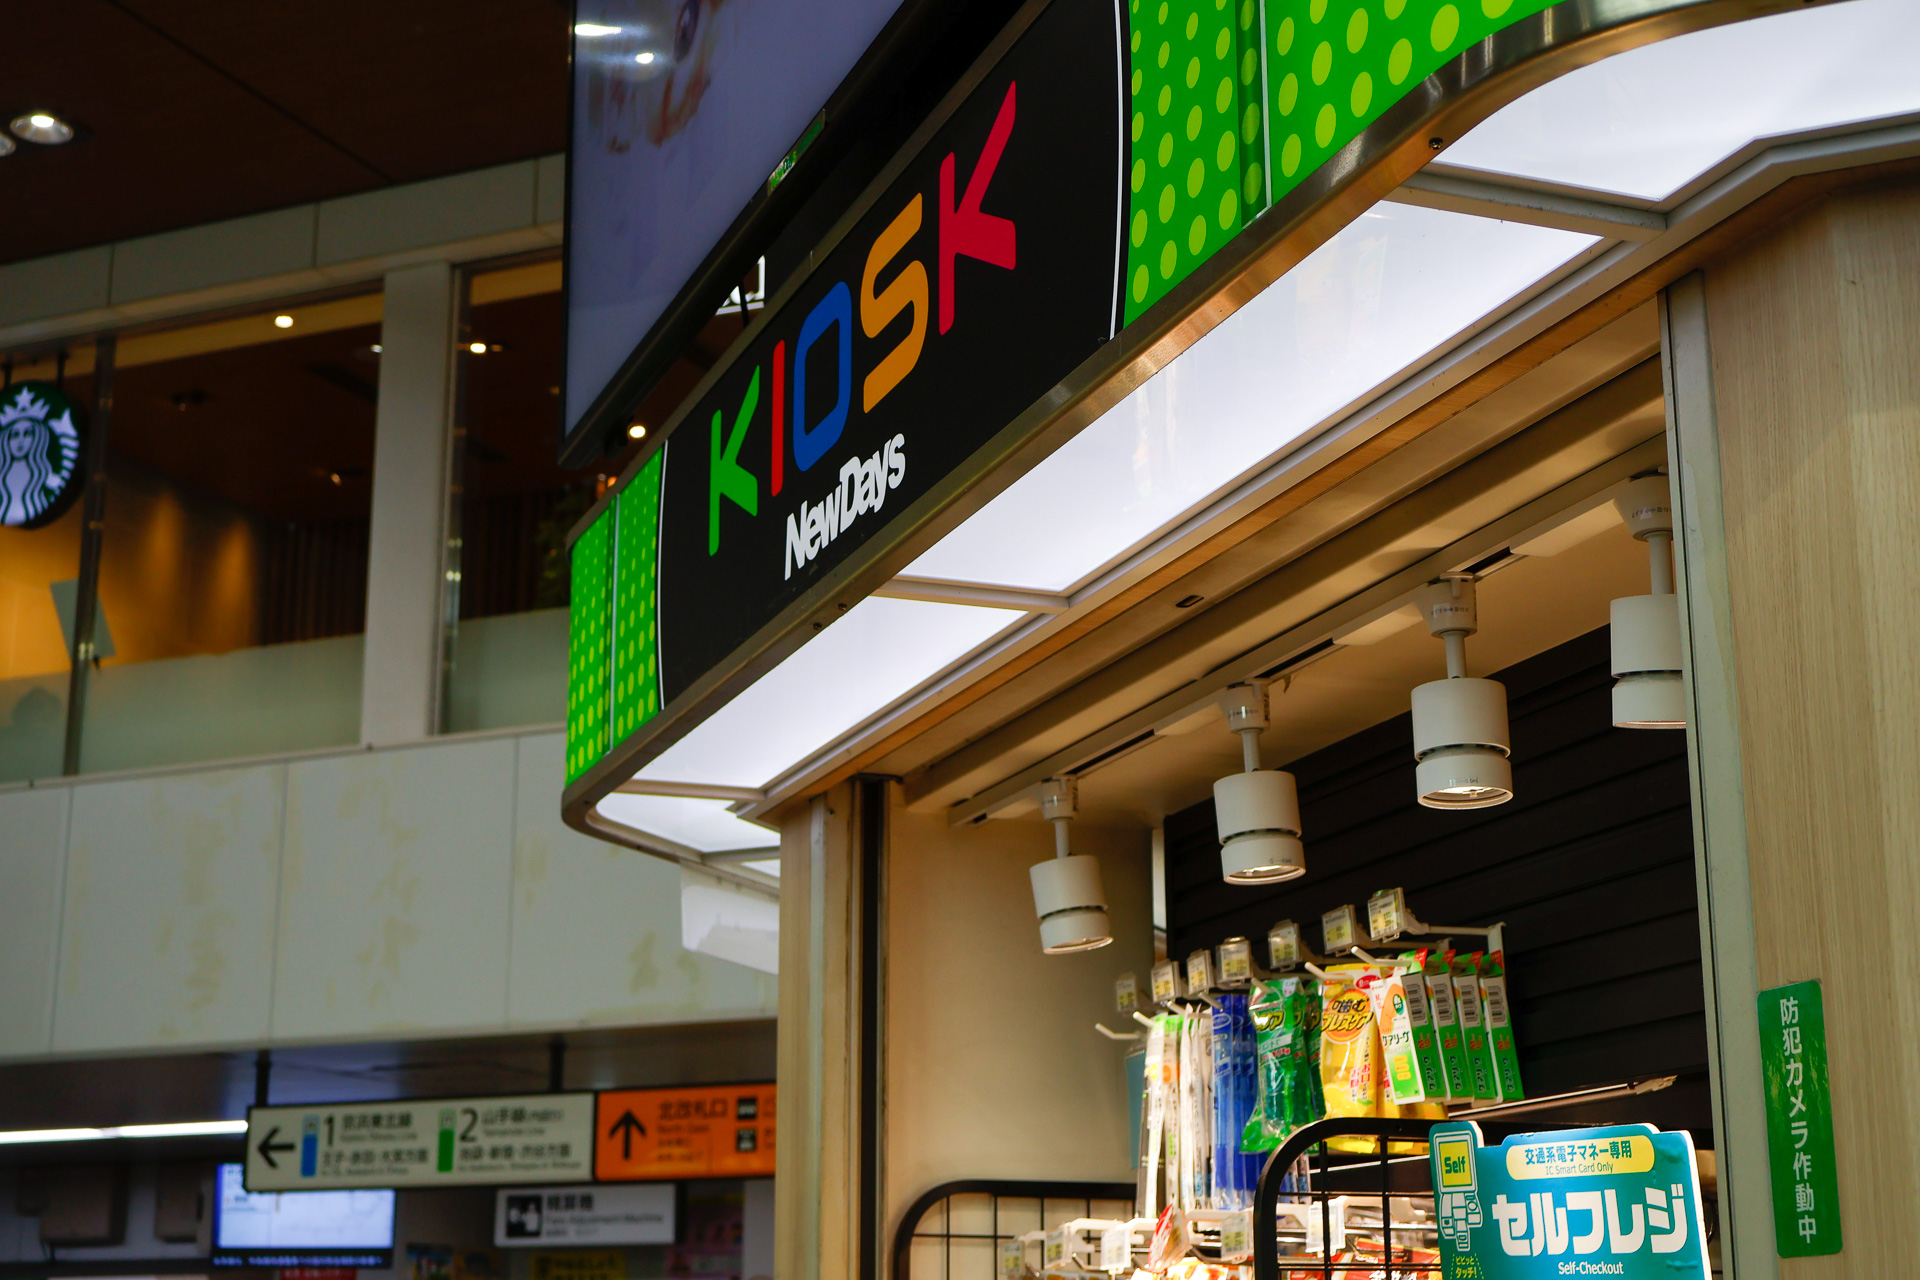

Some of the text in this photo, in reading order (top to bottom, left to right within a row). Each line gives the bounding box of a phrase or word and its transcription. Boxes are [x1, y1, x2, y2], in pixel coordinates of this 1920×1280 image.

[708, 80, 1017, 556] KIOSK
[784, 433, 906, 581] NewDays
[324, 1114, 335, 1147] 1
[459, 1107, 478, 1143] 2
[1779, 997, 1817, 1244] 防犯カメラ作動中
[1444, 1156, 1466, 1174] Self
[1525, 1140, 1632, 1165] 交通系電子マネー専用
[1545, 1161, 1614, 1176] IC Smart Card Only
[1491, 1183, 1688, 1257] セルフレジ
[1558, 1261, 1625, 1275] Self-Checkout
